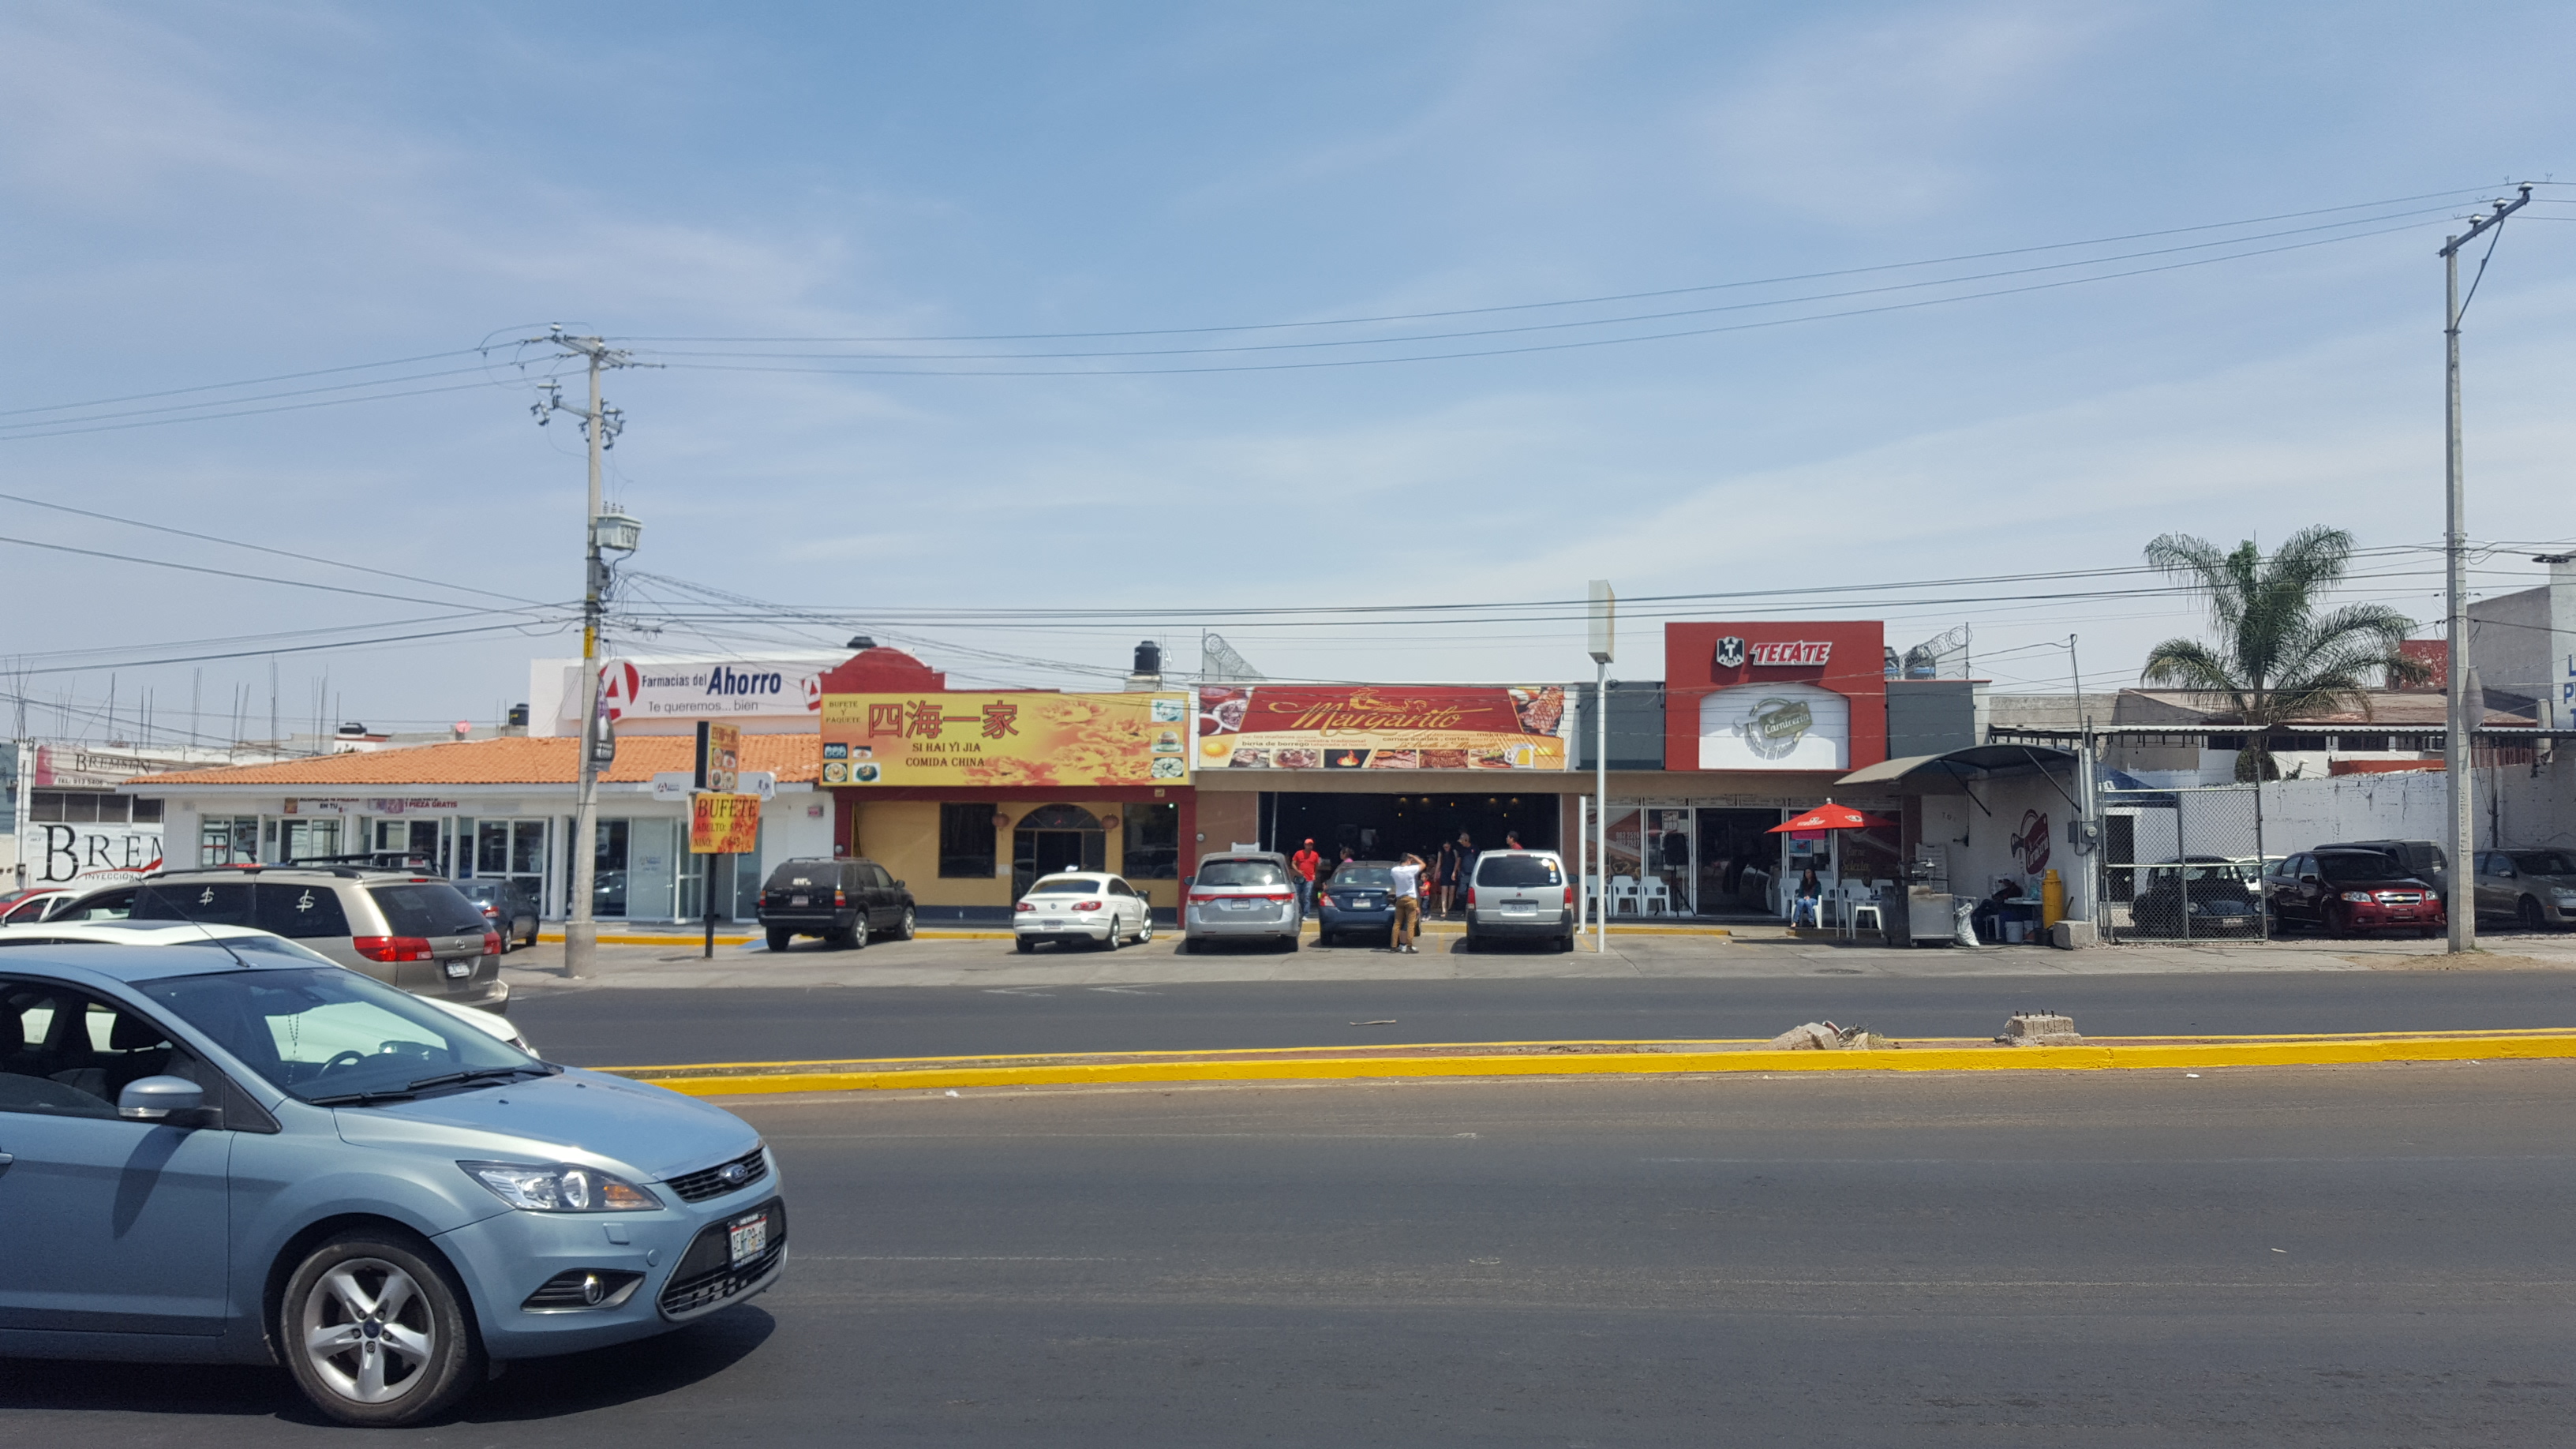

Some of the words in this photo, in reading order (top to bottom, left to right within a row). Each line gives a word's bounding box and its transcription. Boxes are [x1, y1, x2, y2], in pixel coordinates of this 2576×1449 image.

[1751, 642, 1831, 665] TECATE
[642, 675, 690, 687] Farmacias
[693, 673, 707, 687] del
[706, 666, 781, 696] Ahorro
[649, 702, 661, 711] Te
[665, 702, 731, 713] queremos...
[734, 699, 758, 710] bien
[868, 700, 1019, 739] 四海一家
[1269, 702, 1492, 736] Margarito
[912, 743, 923, 752] SI
[926, 743, 945, 752] HAI
[963, 743, 981, 752] JIA
[906, 757, 948, 767] COMIDA
[951, 758, 985, 767] CHINA
[698, 798, 758, 820] BUFETE
